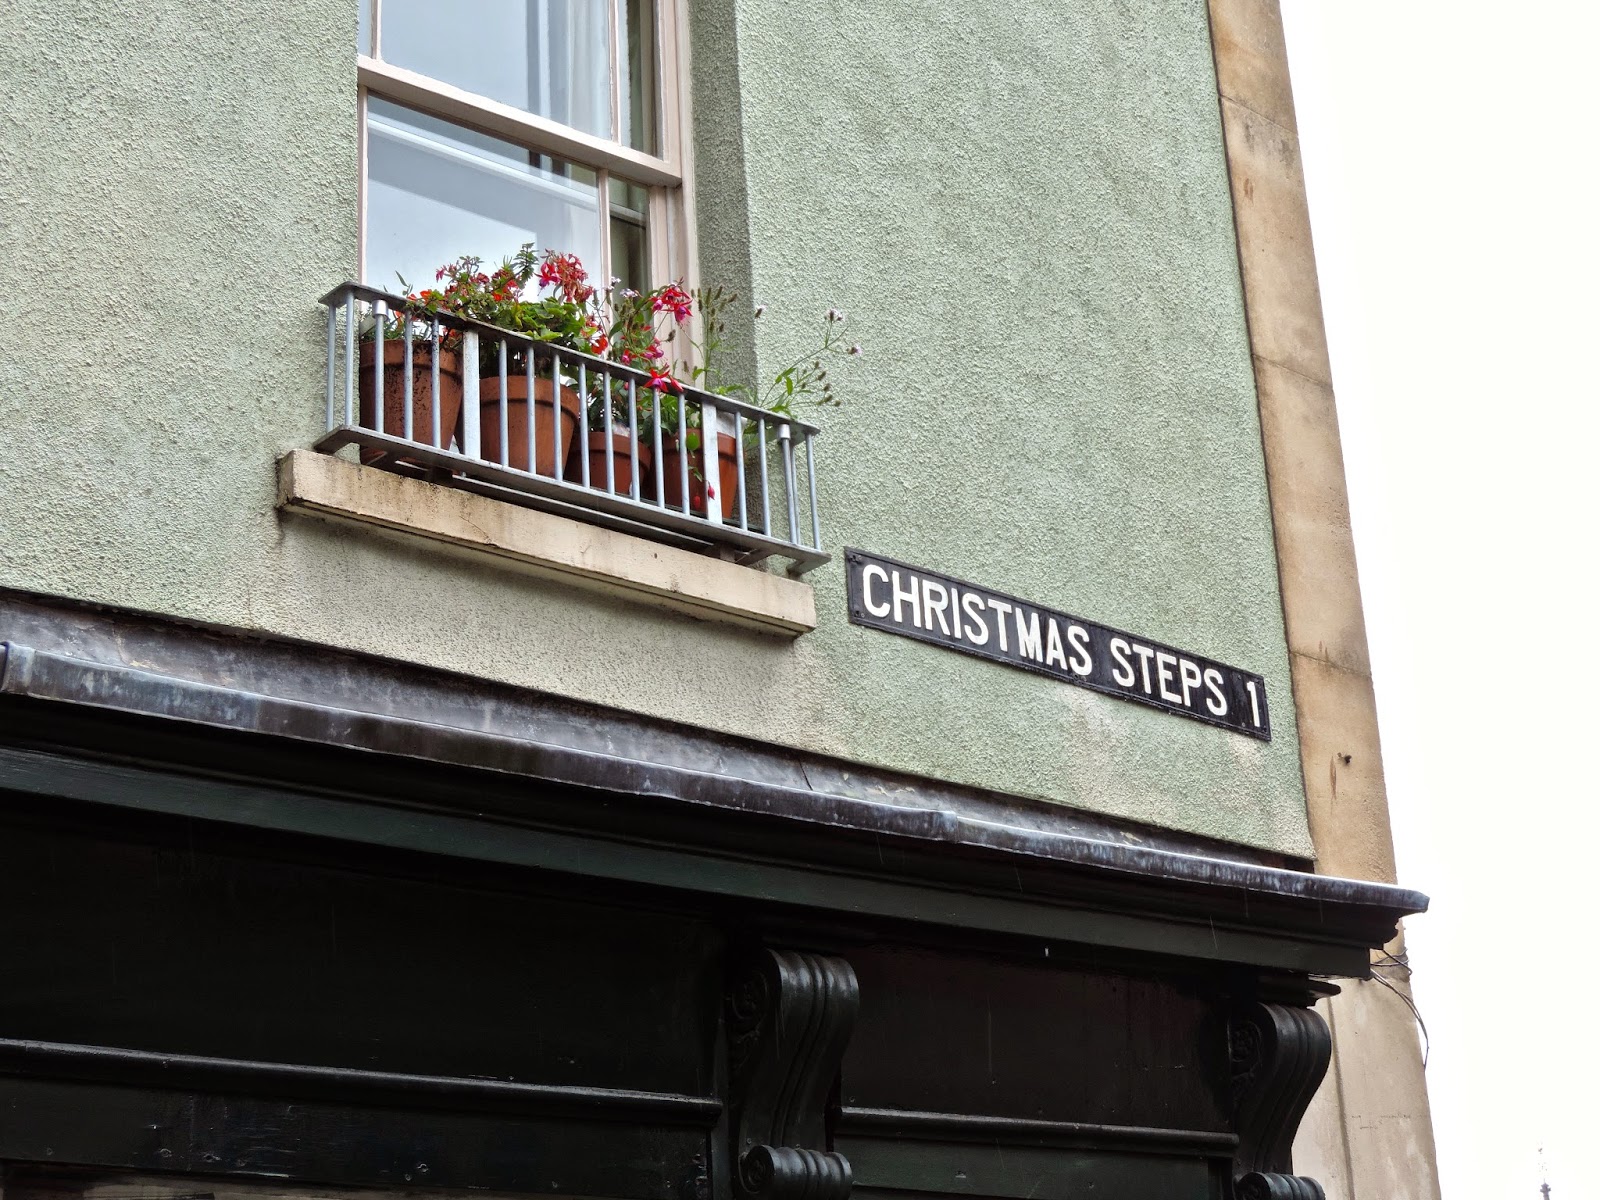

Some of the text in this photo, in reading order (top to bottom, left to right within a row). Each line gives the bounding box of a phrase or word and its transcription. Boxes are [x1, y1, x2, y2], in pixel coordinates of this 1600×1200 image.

[862, 563, 1261, 728] CHRISTMAS STEPS 1
